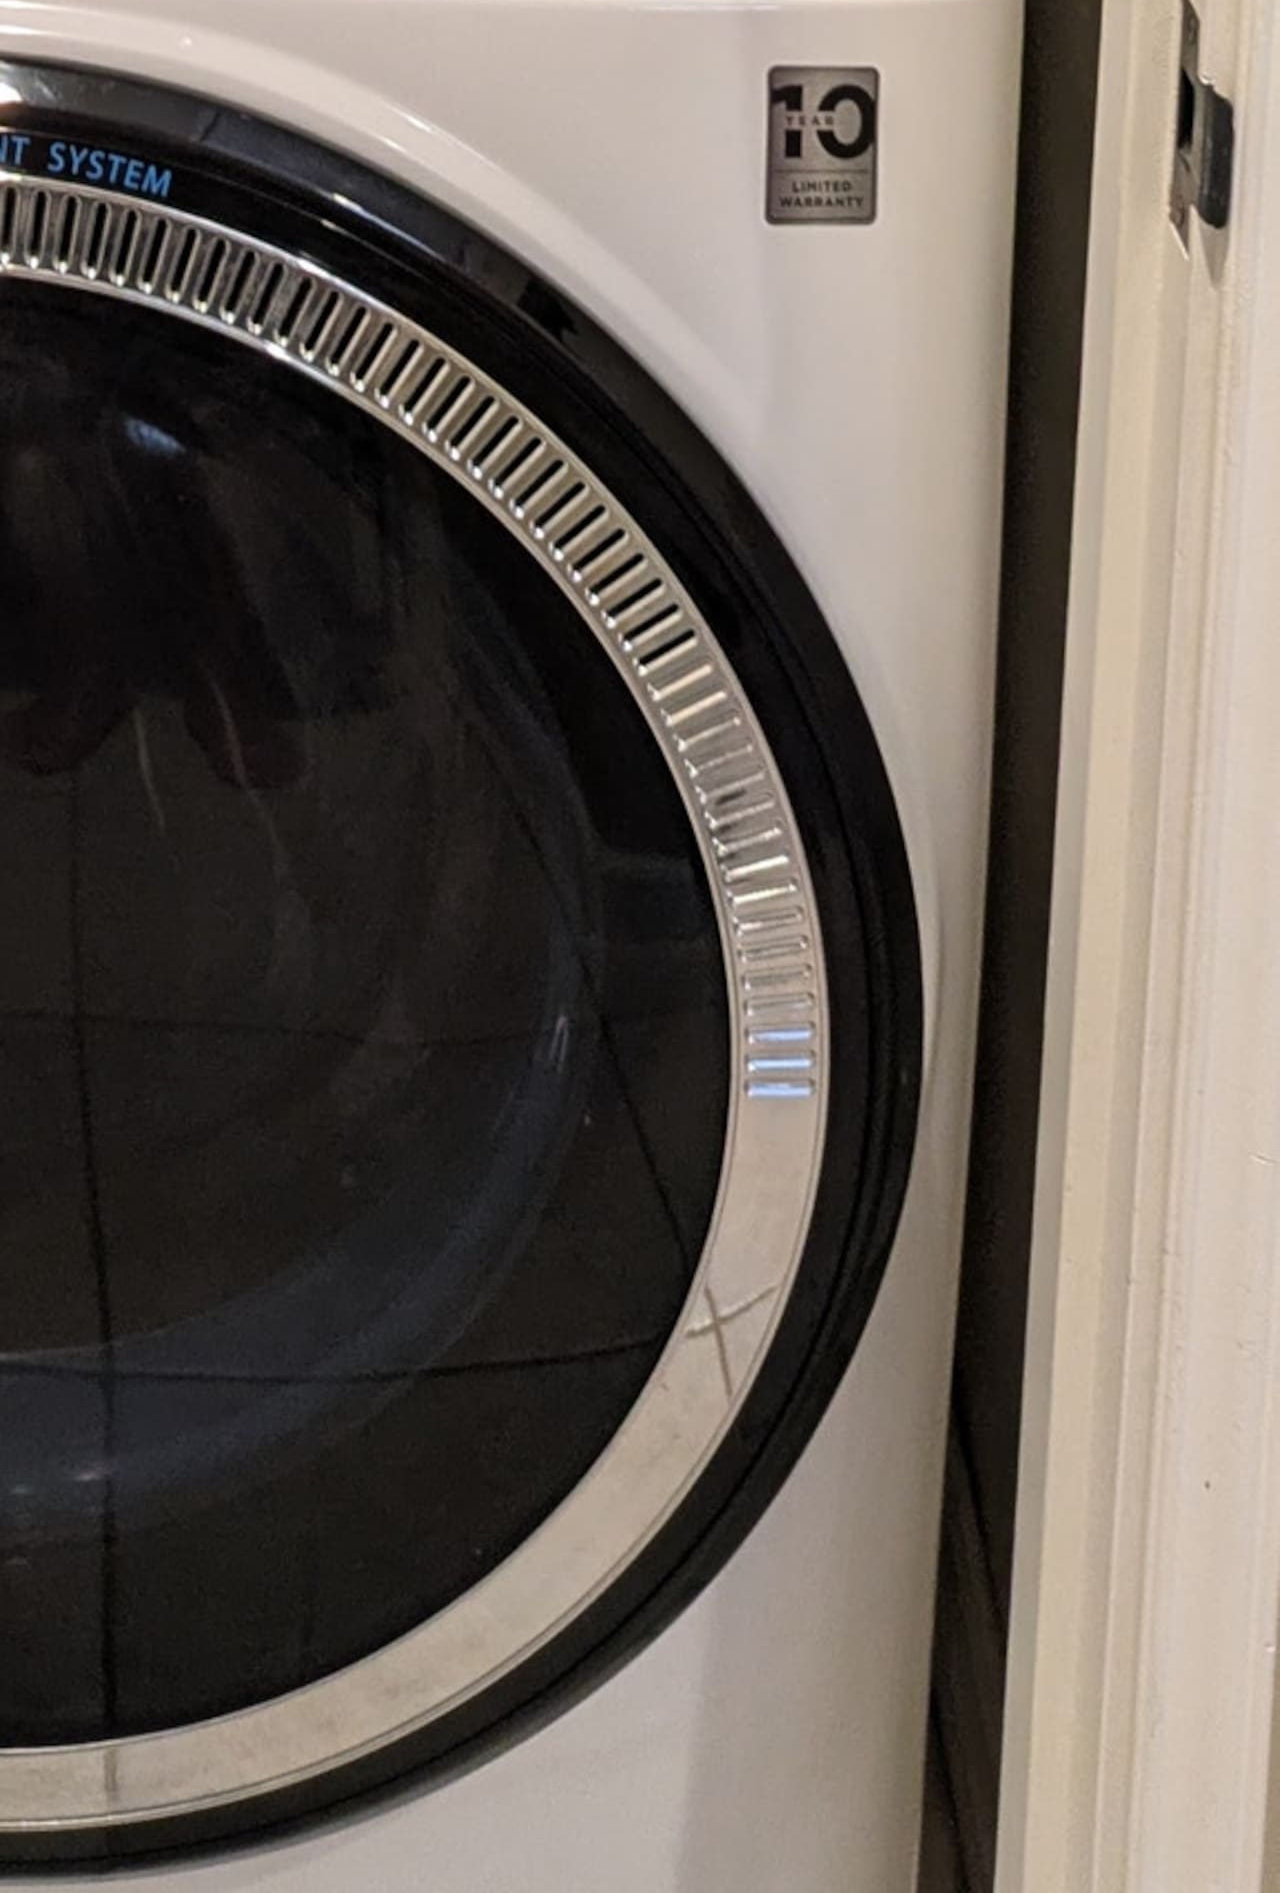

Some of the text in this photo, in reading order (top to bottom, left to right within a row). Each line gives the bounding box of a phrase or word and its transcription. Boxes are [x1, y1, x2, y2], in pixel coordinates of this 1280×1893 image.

[771, 83, 876, 159] 10
[785, 116, 834, 126] YEAR
[46, 140, 174, 198] SYSTEM
[792, 180, 853, 193] LIMITED
[779, 196, 864, 208] WARRANTY
